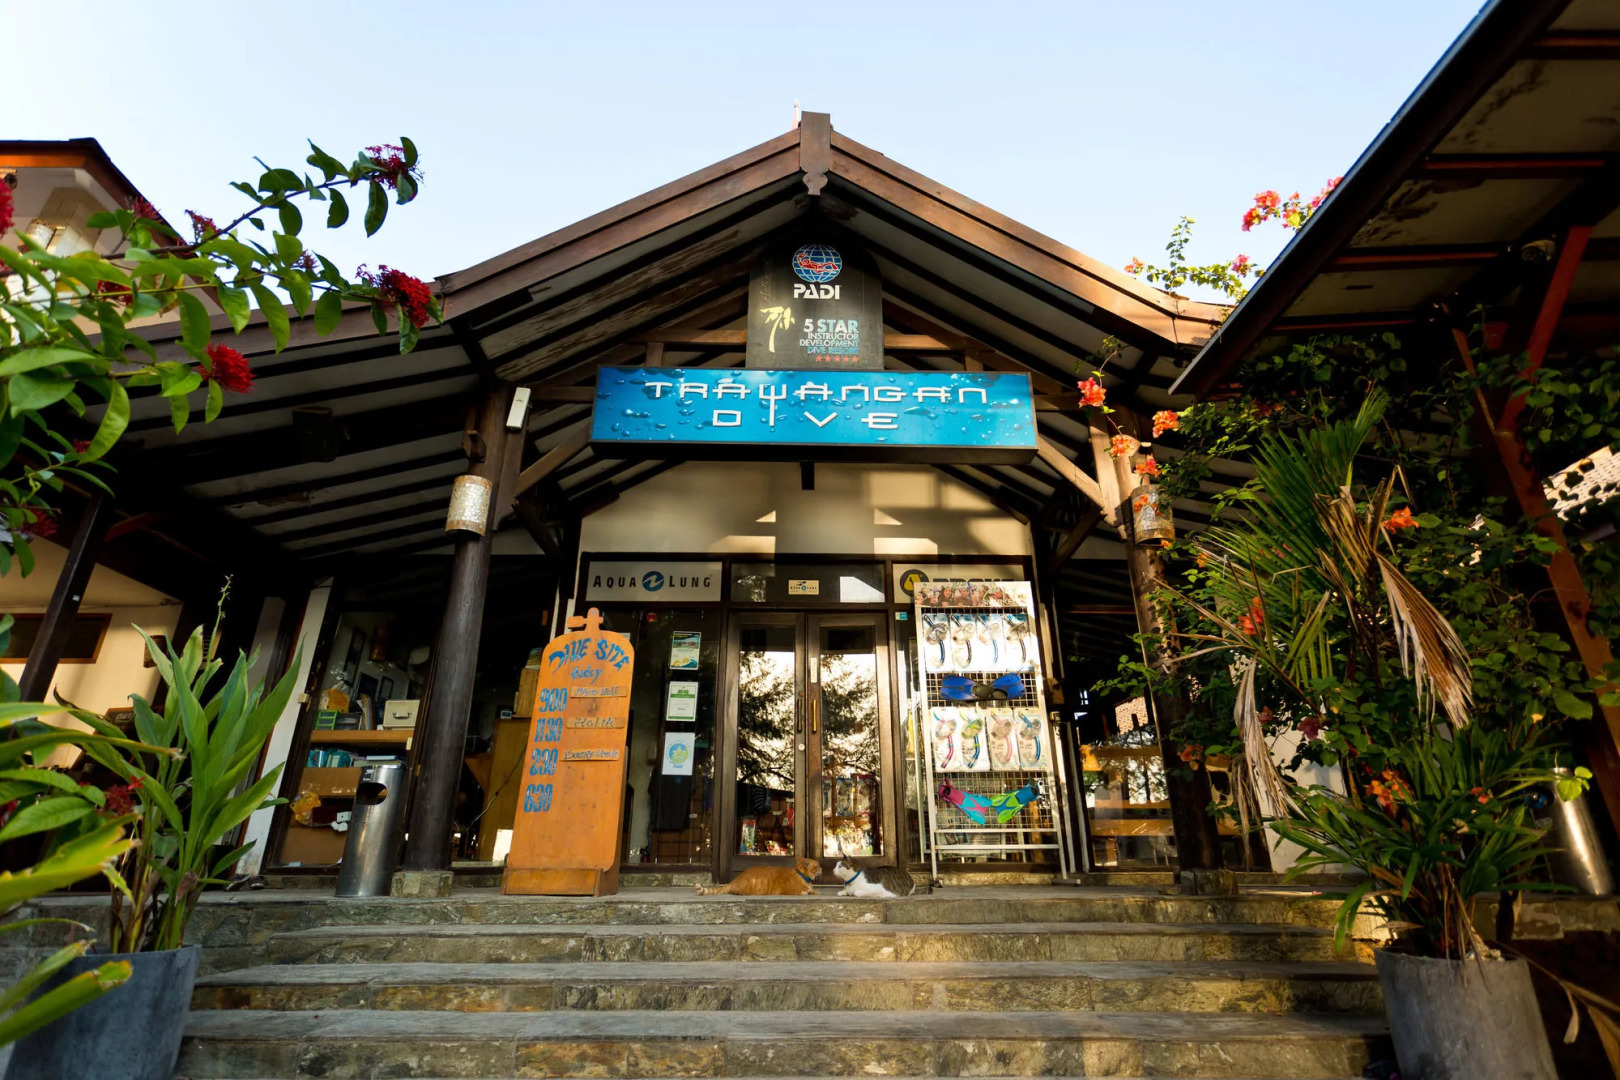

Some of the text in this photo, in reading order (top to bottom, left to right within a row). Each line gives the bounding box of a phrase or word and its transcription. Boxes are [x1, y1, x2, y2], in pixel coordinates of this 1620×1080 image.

[793, 283, 841, 300] PADI
[803, 318, 859, 334] 5 STAR
[799, 339, 859, 348] DEVELOPMENT
[807, 332, 859, 341] INSTRUCTOR
[807, 346, 859, 355] DIVE RESORT
[593, 575, 711, 589] AQUA LUNG
[548, 637, 630, 675] DIVE SITE
[570, 665, 603, 685] today
[539, 688, 568, 712] 900
[533, 717, 563, 743] 1130
[529, 748, 559, 776] 230
[523, 783, 554, 813] 630
